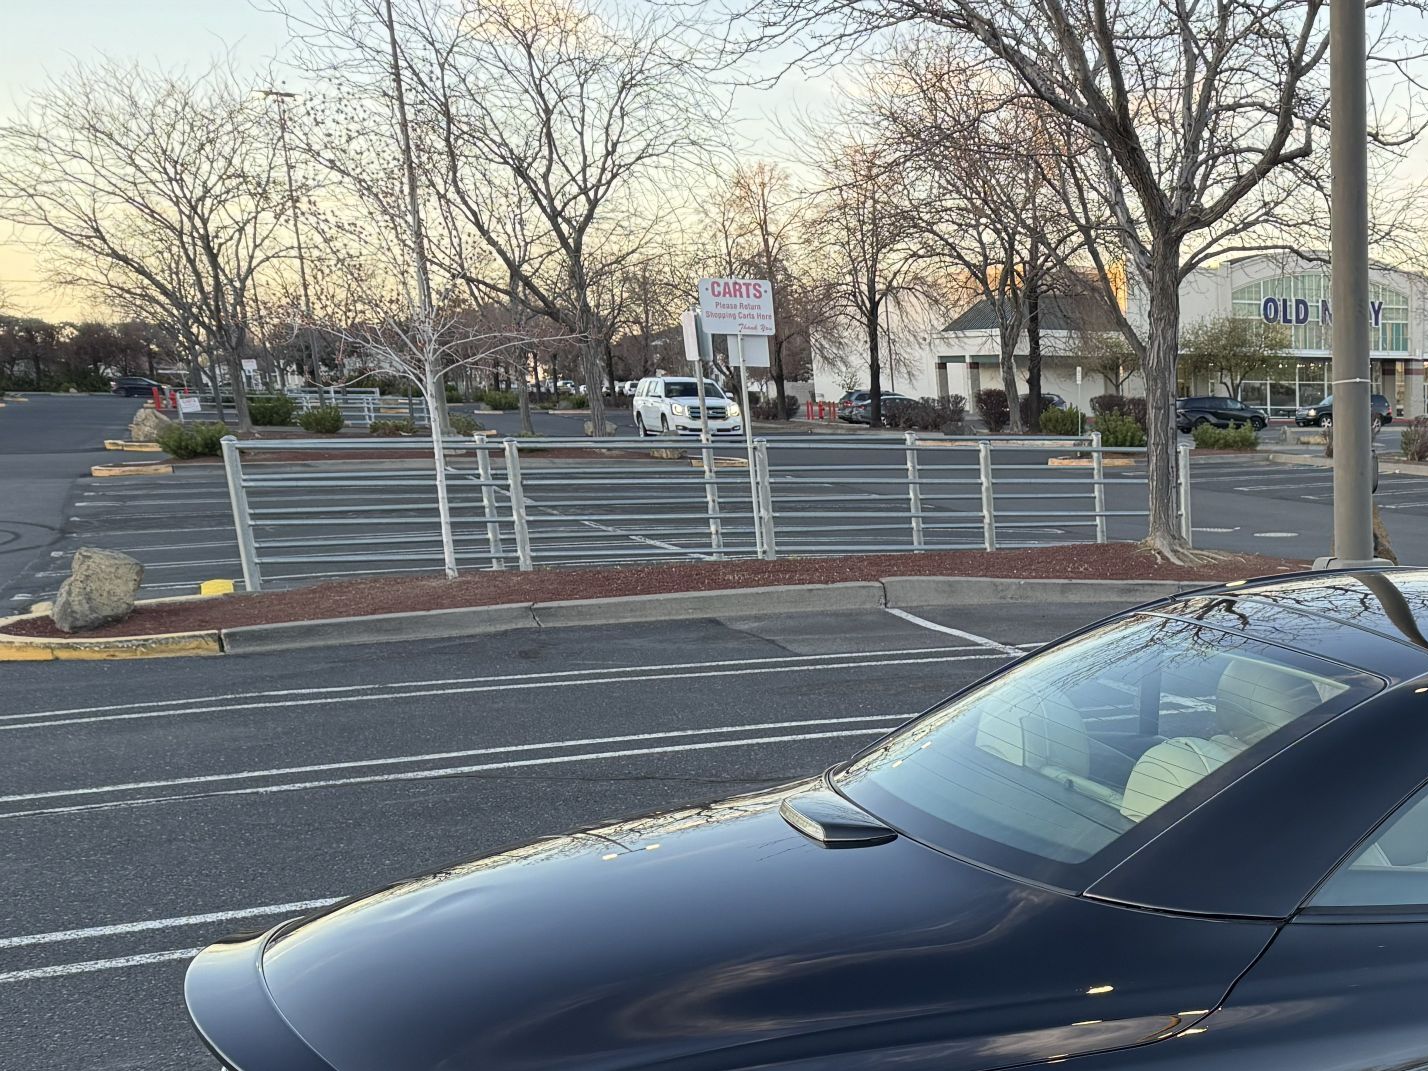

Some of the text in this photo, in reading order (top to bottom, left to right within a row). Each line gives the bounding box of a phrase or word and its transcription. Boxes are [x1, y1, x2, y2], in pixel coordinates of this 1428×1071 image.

[710, 280, 763, 300] CARTS
[715, 301, 762, 311] Please Return
[1262, 295, 1384, 327] OLD NY
[705, 310, 773, 320] Shopping Carts Here
[738, 323, 773, 332] Thank You
